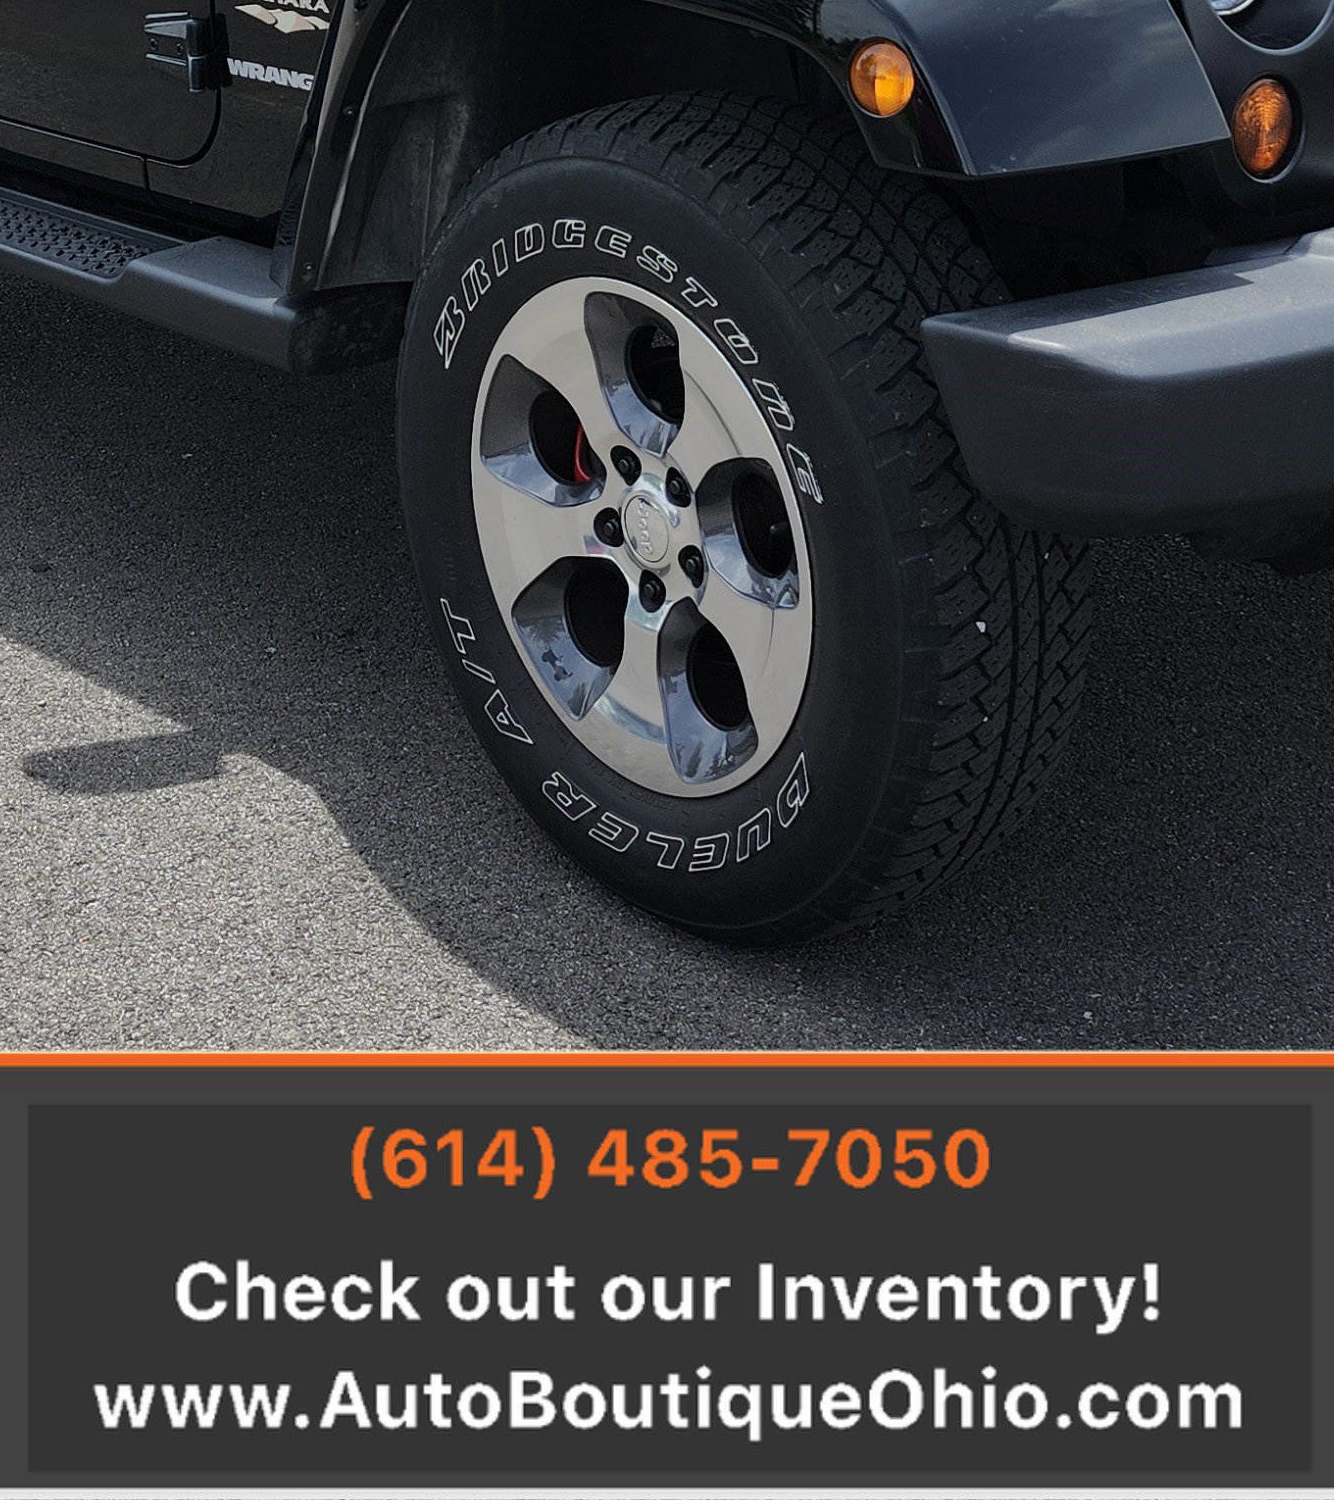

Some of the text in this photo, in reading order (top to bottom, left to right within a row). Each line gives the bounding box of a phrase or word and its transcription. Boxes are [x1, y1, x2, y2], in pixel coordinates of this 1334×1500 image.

[227, 57, 314, 91] WRANG
[433, 219, 824, 504] BRIDGESTONE
[440, 597, 535, 745] A/T
[542, 752, 810, 873] DUELER
